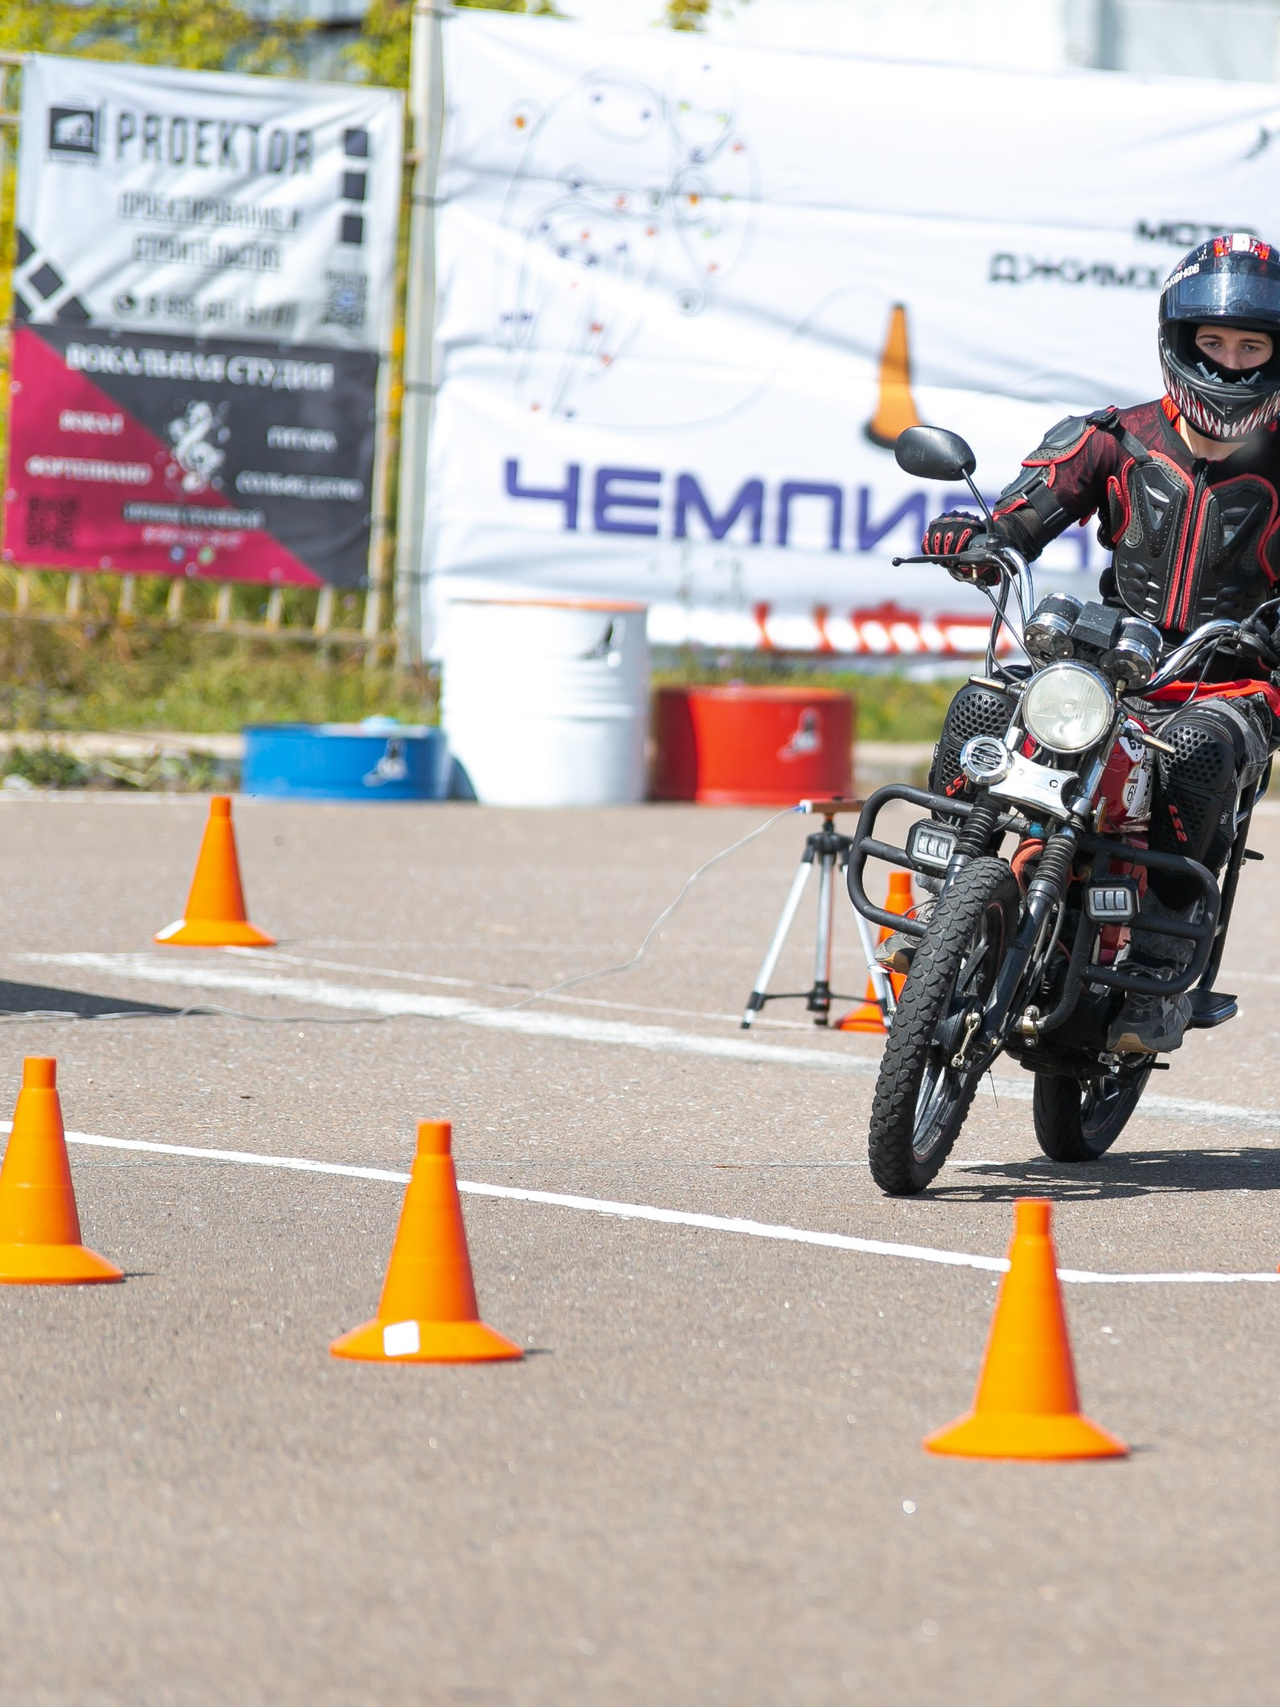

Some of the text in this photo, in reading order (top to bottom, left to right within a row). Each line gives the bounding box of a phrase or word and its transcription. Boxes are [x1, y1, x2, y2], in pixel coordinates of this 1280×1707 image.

[115, 110, 315, 175] PROEKTOR
[1135, 218, 1260, 246] МОТ
[988, 252, 1166, 291] ДЖИМХ
[65, 341, 336, 392] ВОКАЛЬНАЯ СТУДИЯ
[1167, 804, 1188, 842] LS2
